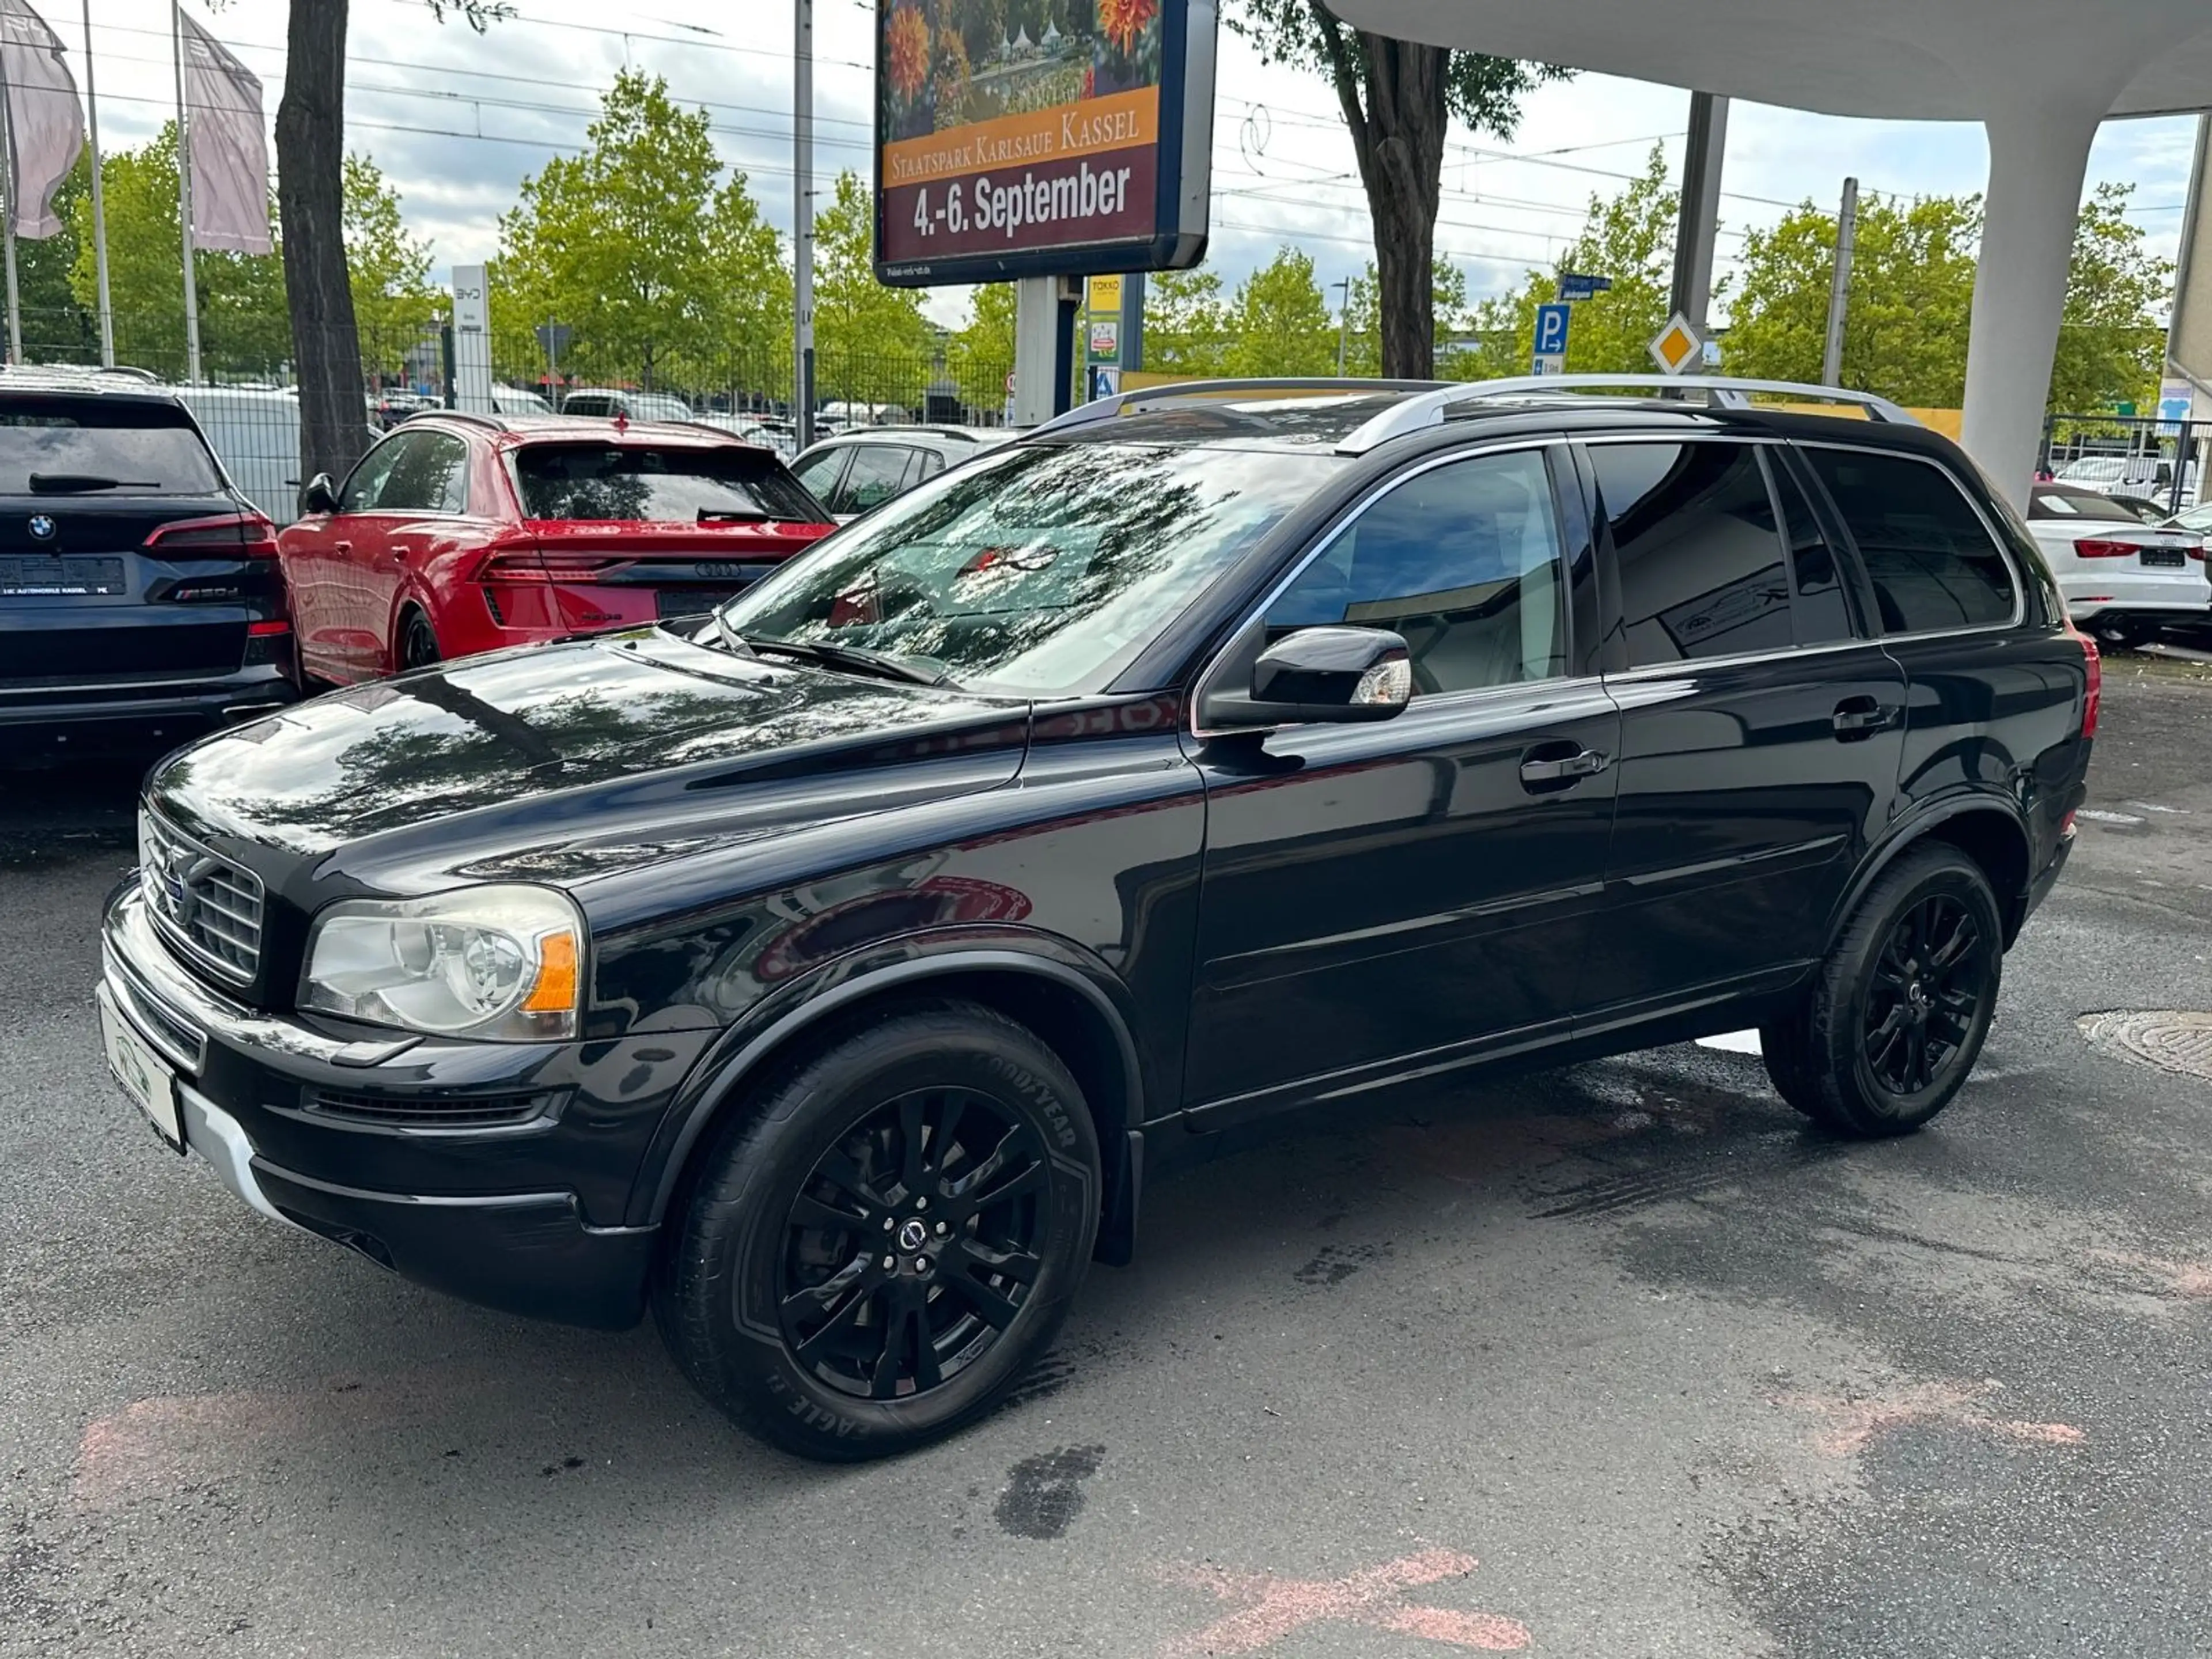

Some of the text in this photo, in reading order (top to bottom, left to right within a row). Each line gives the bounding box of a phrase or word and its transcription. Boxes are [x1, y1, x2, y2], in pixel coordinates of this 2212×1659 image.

[892, 110, 1139, 180] STAATSPARK KARLSAUE KASSEL
[914, 162, 1130, 238] 4.-6. September
[1541, 311, 1562, 350] P
